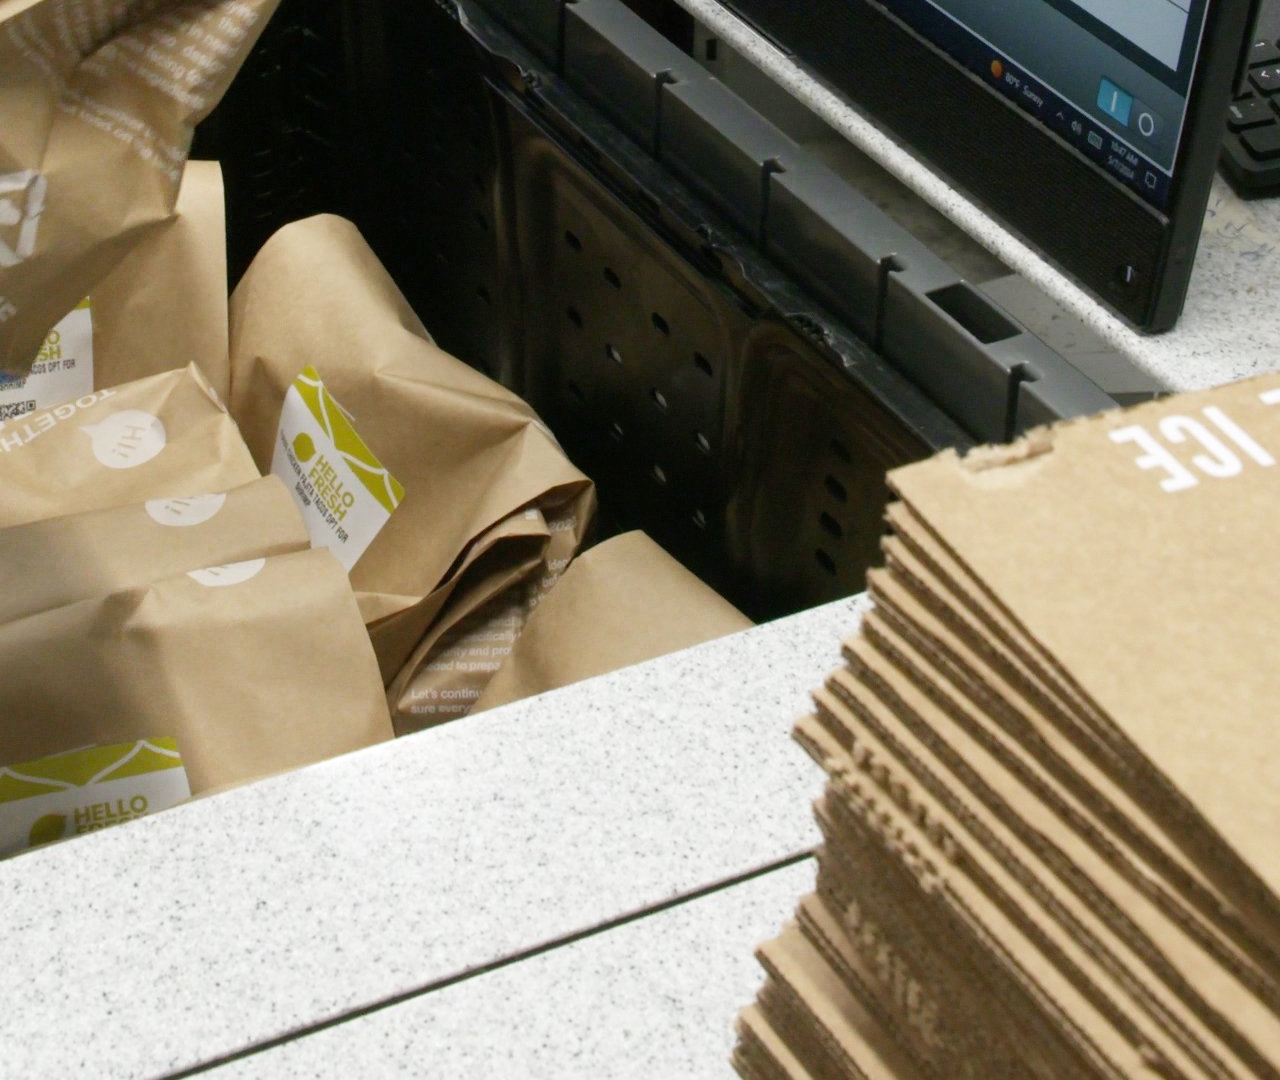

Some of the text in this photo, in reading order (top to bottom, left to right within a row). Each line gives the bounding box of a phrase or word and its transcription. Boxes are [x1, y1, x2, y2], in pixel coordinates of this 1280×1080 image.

[62, 358, 77, 370] FOR
[1108, 405, 1277, 494] ICE
[308, 466, 348, 522] FRESH
[314, 453, 356, 509] HELLO
[300, 472, 315, 497] FAJITA
[312, 492, 329, 519] TACOS
[324, 513, 339, 530] OPT
[335, 524, 349, 544] FOR
[455, 659, 469, 671] to
[410, 687, 437, 700] Let's
[410, 705, 436, 715] sure
[73, 794, 149, 825] HELLO
